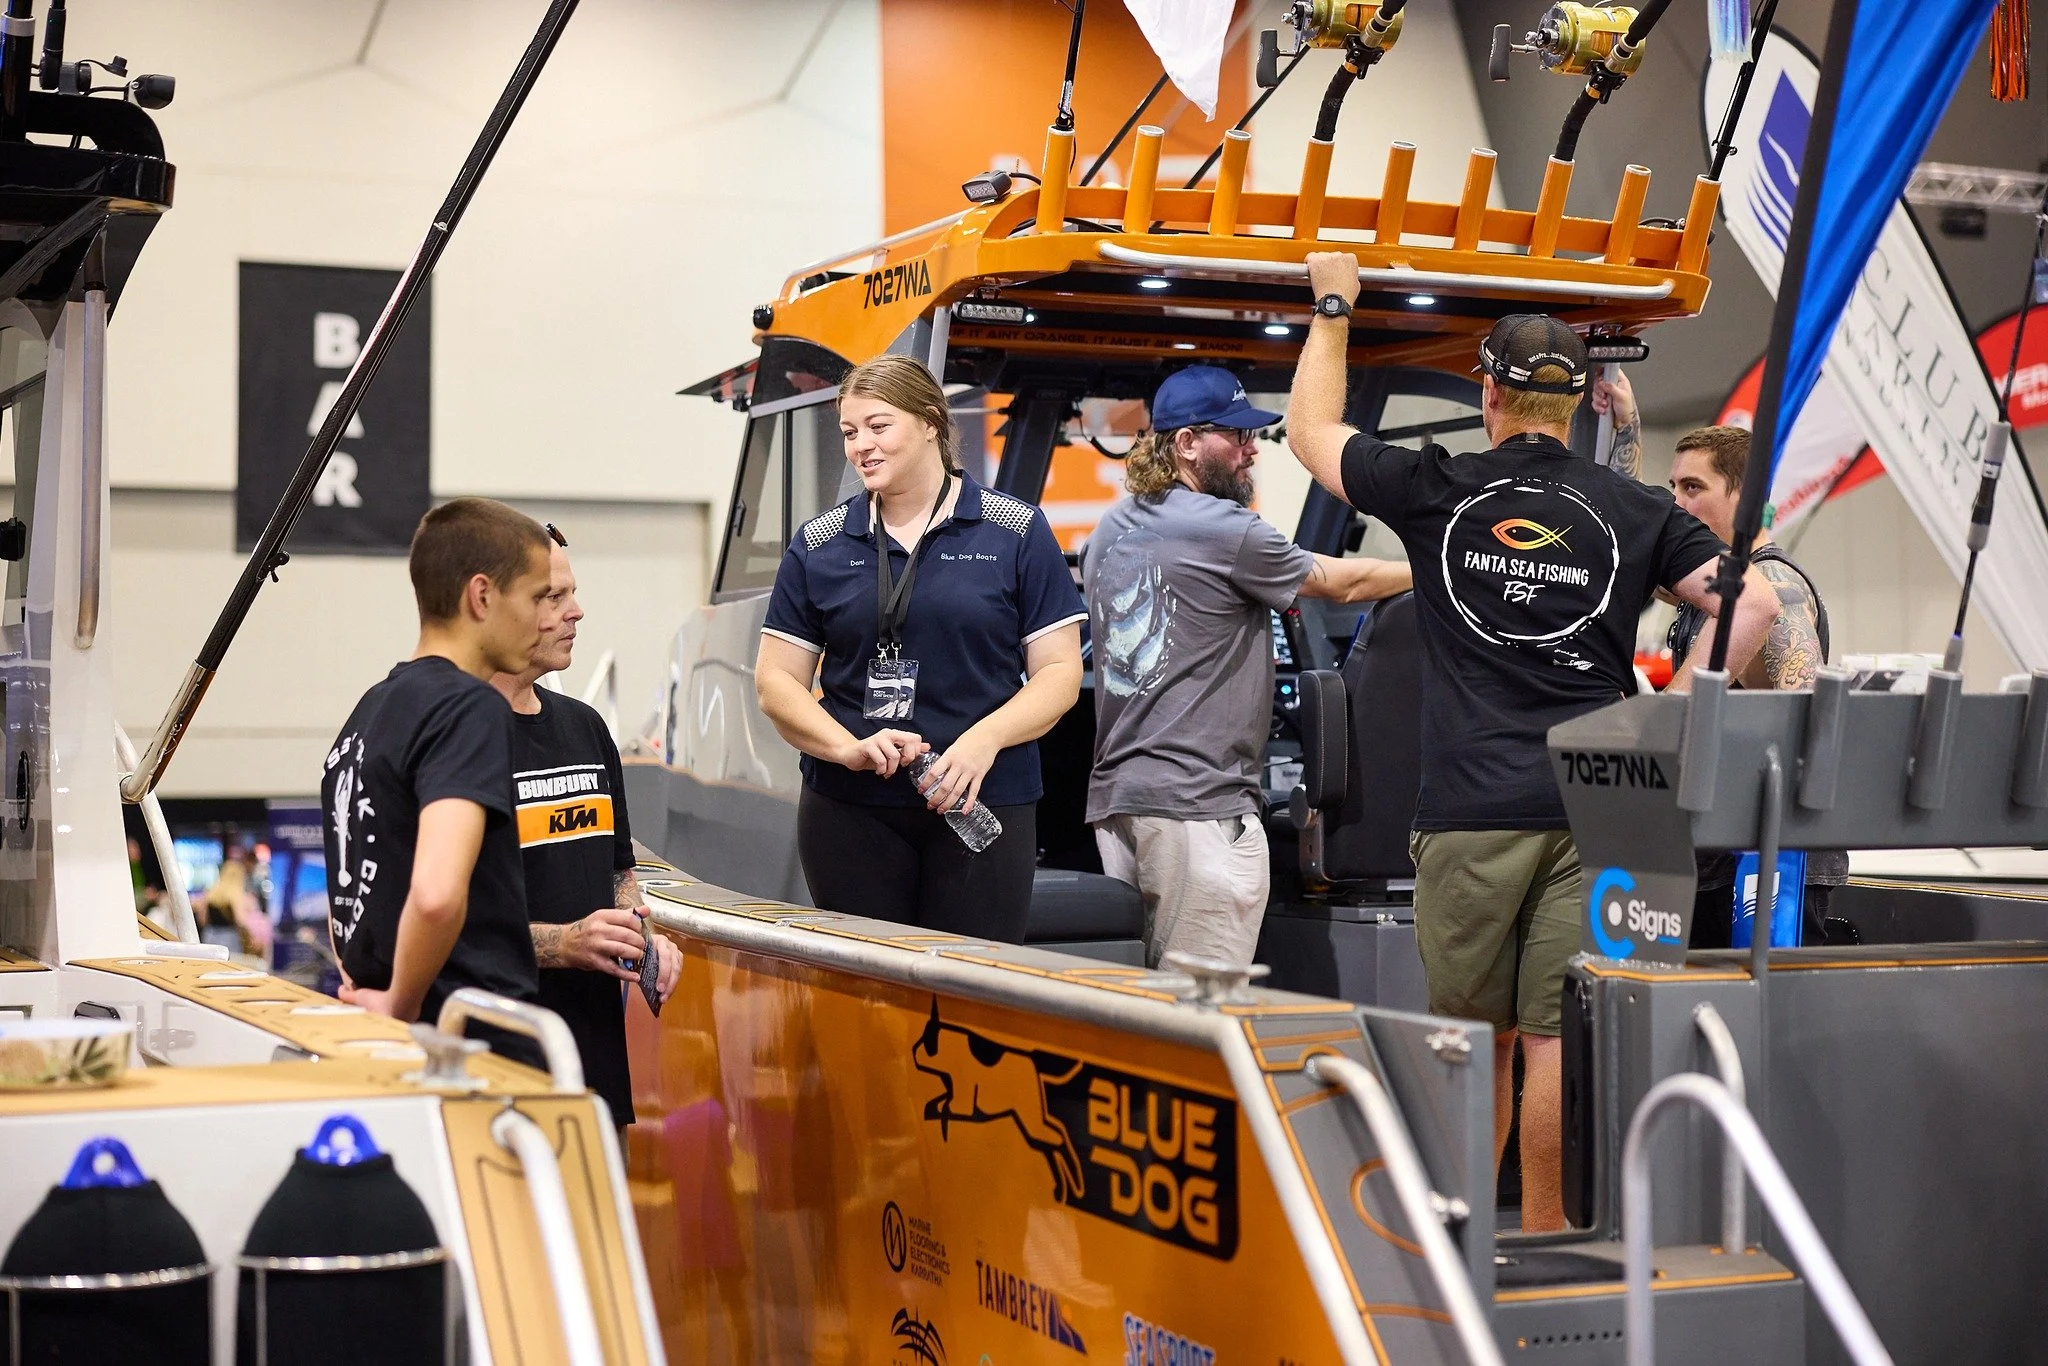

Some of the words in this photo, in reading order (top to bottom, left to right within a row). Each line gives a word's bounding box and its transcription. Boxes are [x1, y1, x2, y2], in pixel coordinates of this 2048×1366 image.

[863, 259, 932, 309] 7027WA
[969, 329, 983, 338] IT
[1093, 335, 1106, 344] IT
[1109, 336, 1151, 347] MUST
[940, 552, 955, 561] Blue
[975, 553, 998, 561] Boats
[1464, 551, 1507, 574] FANTA
[1509, 558, 1535, 580] SEA
[1538, 563, 1589, 586] FISHING
[1503, 581, 1546, 605] FSF
[517, 773, 599, 800] BUNBURY
[1561, 752, 1669, 789] 7027WA
[549, 804, 598, 834] KTM
[1627, 899, 1682, 942] Signs
[1088, 1077, 1218, 1172] BLUE
[1090, 1145, 1219, 1245] DOG
[910, 1245, 951, 1275] ELECTRONICS
[976, 1260, 1050, 1337] TAMBREY
